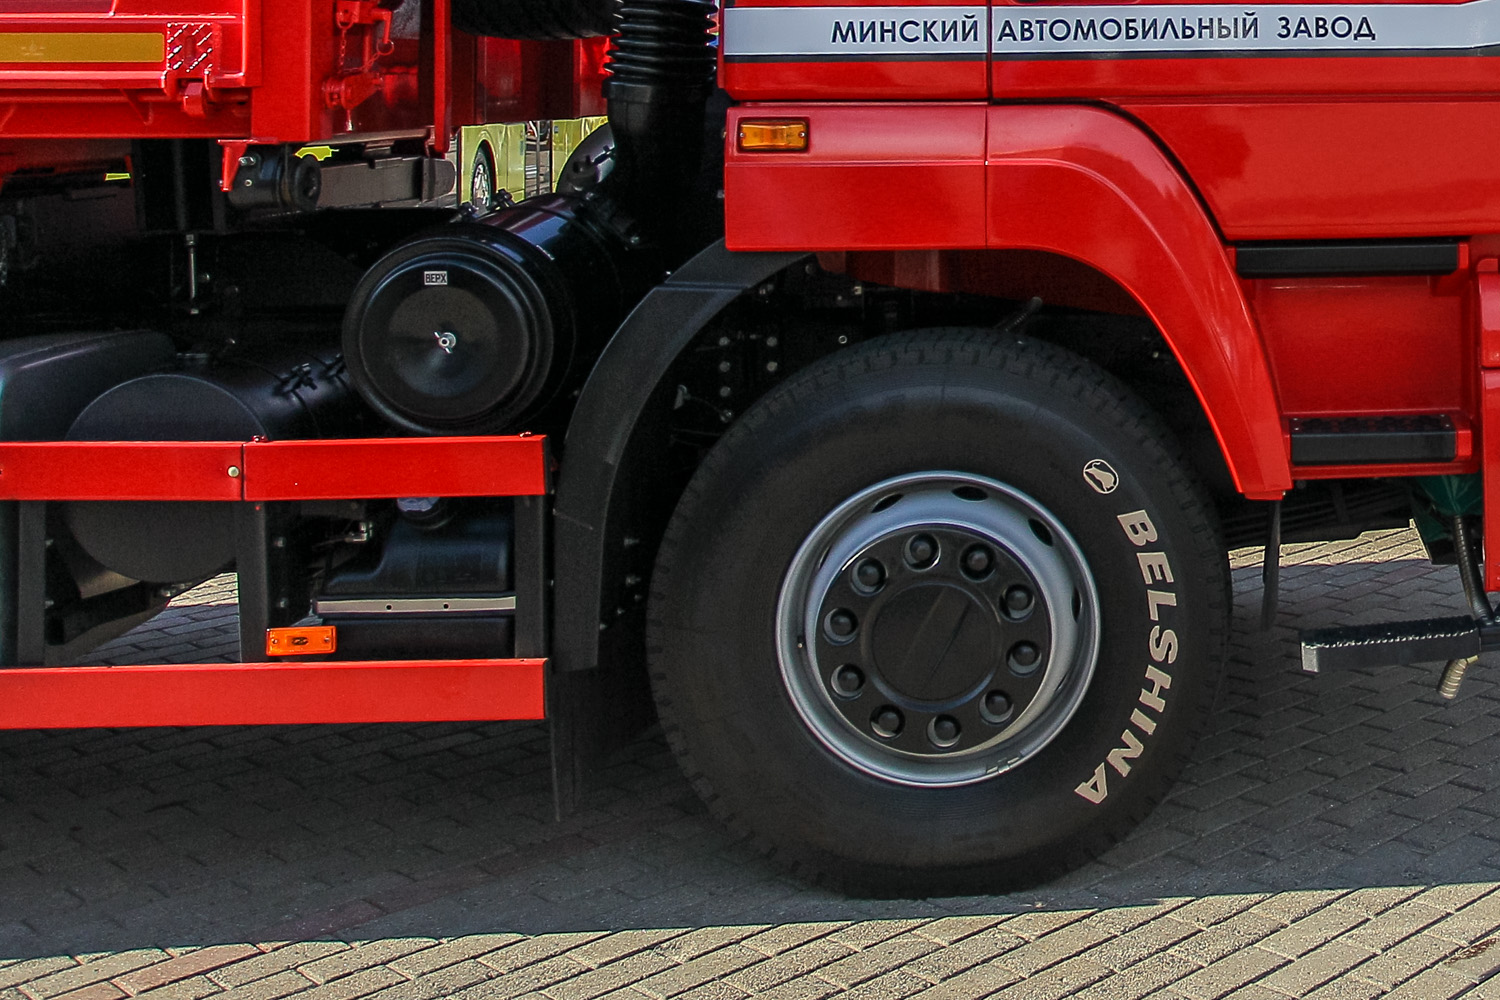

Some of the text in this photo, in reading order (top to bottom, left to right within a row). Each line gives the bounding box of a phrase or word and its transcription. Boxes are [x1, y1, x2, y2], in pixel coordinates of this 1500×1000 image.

[831, 11, 1376, 44] МИНСКИЙ АВТОМОБИЛЬНЫЙ ЗАВОД
[425, 273, 447, 283] ВЕРХ
[1074, 508, 1178, 804] BELSHINA
